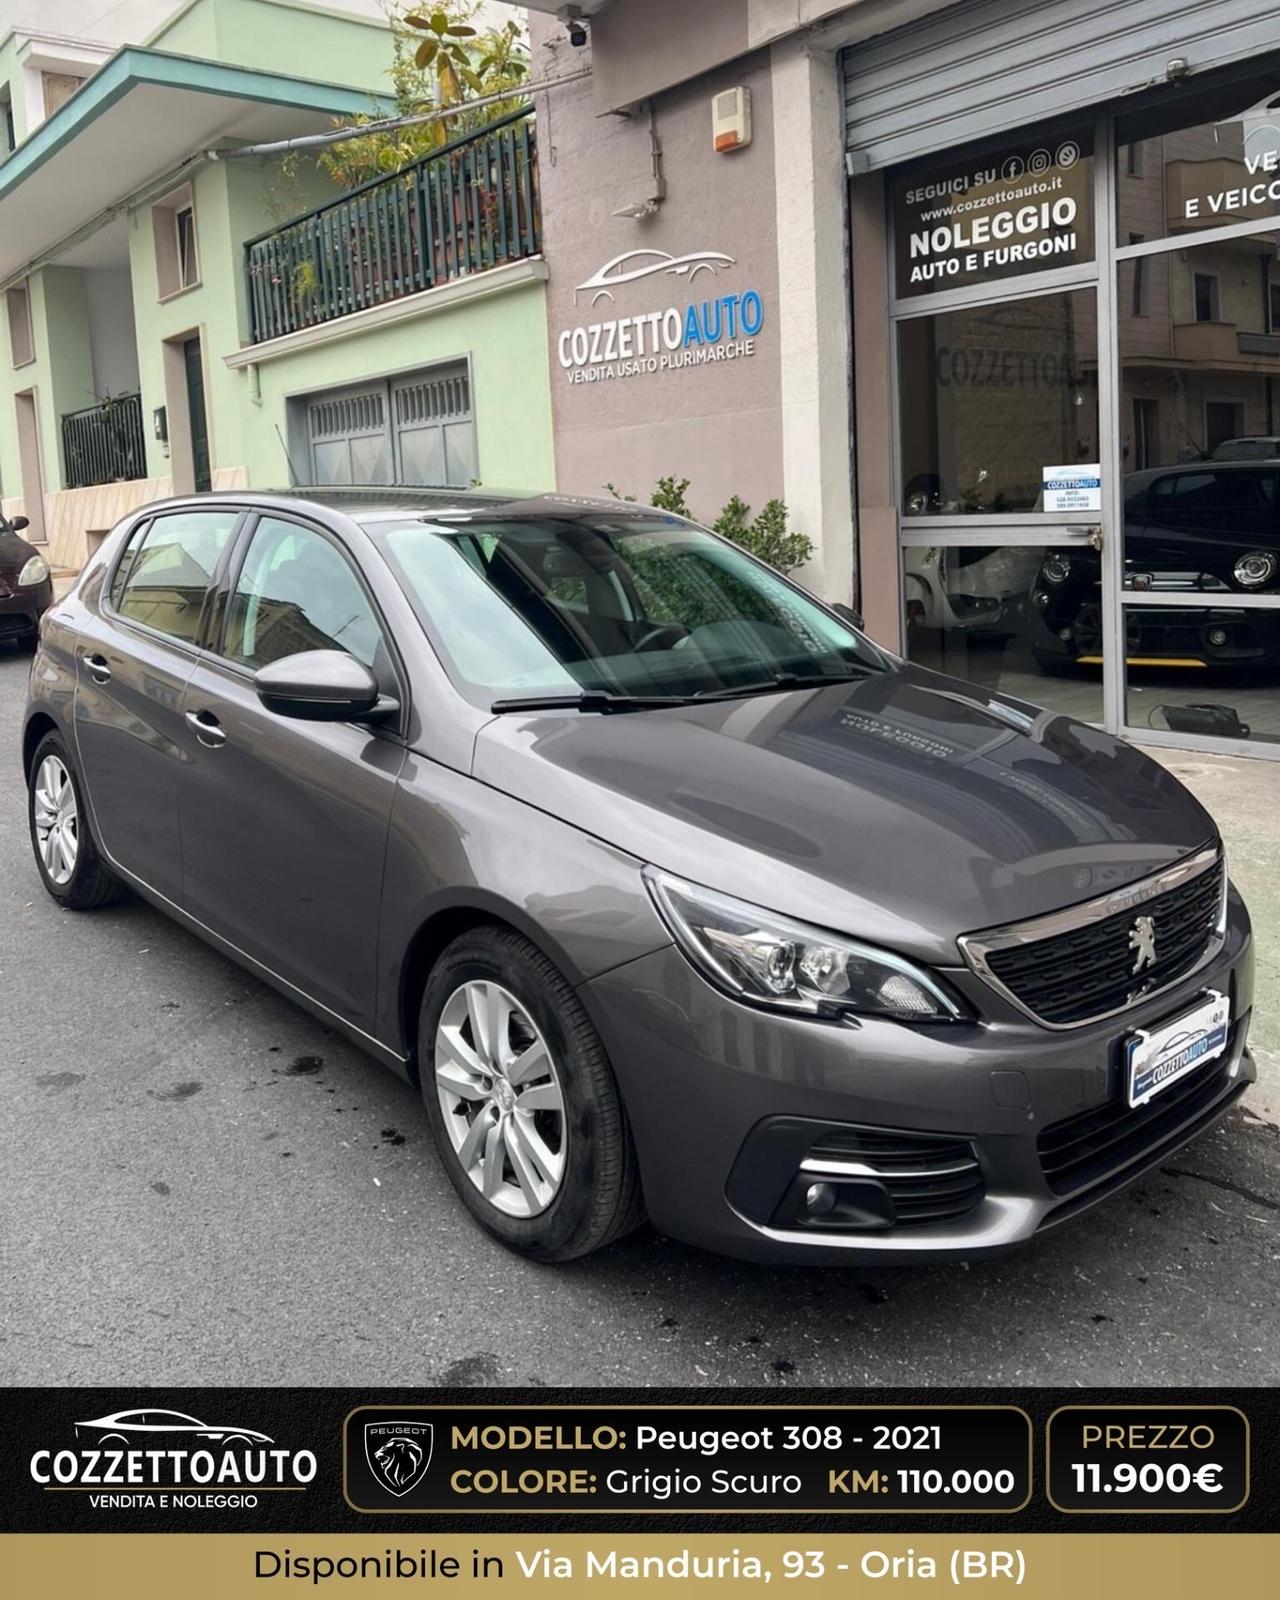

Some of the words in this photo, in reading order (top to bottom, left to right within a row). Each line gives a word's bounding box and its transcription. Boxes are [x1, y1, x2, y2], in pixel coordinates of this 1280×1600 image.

[905, 176, 969, 205] SEGUICI
[974, 168, 997, 186] SU
[920, 175, 1063, 222] www.cozzettoauto.it
[1185, 198, 1200, 219] E
[909, 196, 1078, 259] NOLEGGIO
[909, 257, 960, 284] AUTO
[965, 254, 978, 272] E
[983, 232, 1077, 269] FURGONI
[557, 288, 764, 369] COZZETTOAUTO
[566, 363, 616, 385] VENDITA
[617, 358, 658, 378] USATO
[660, 338, 756, 371] PLURIMARCHE
